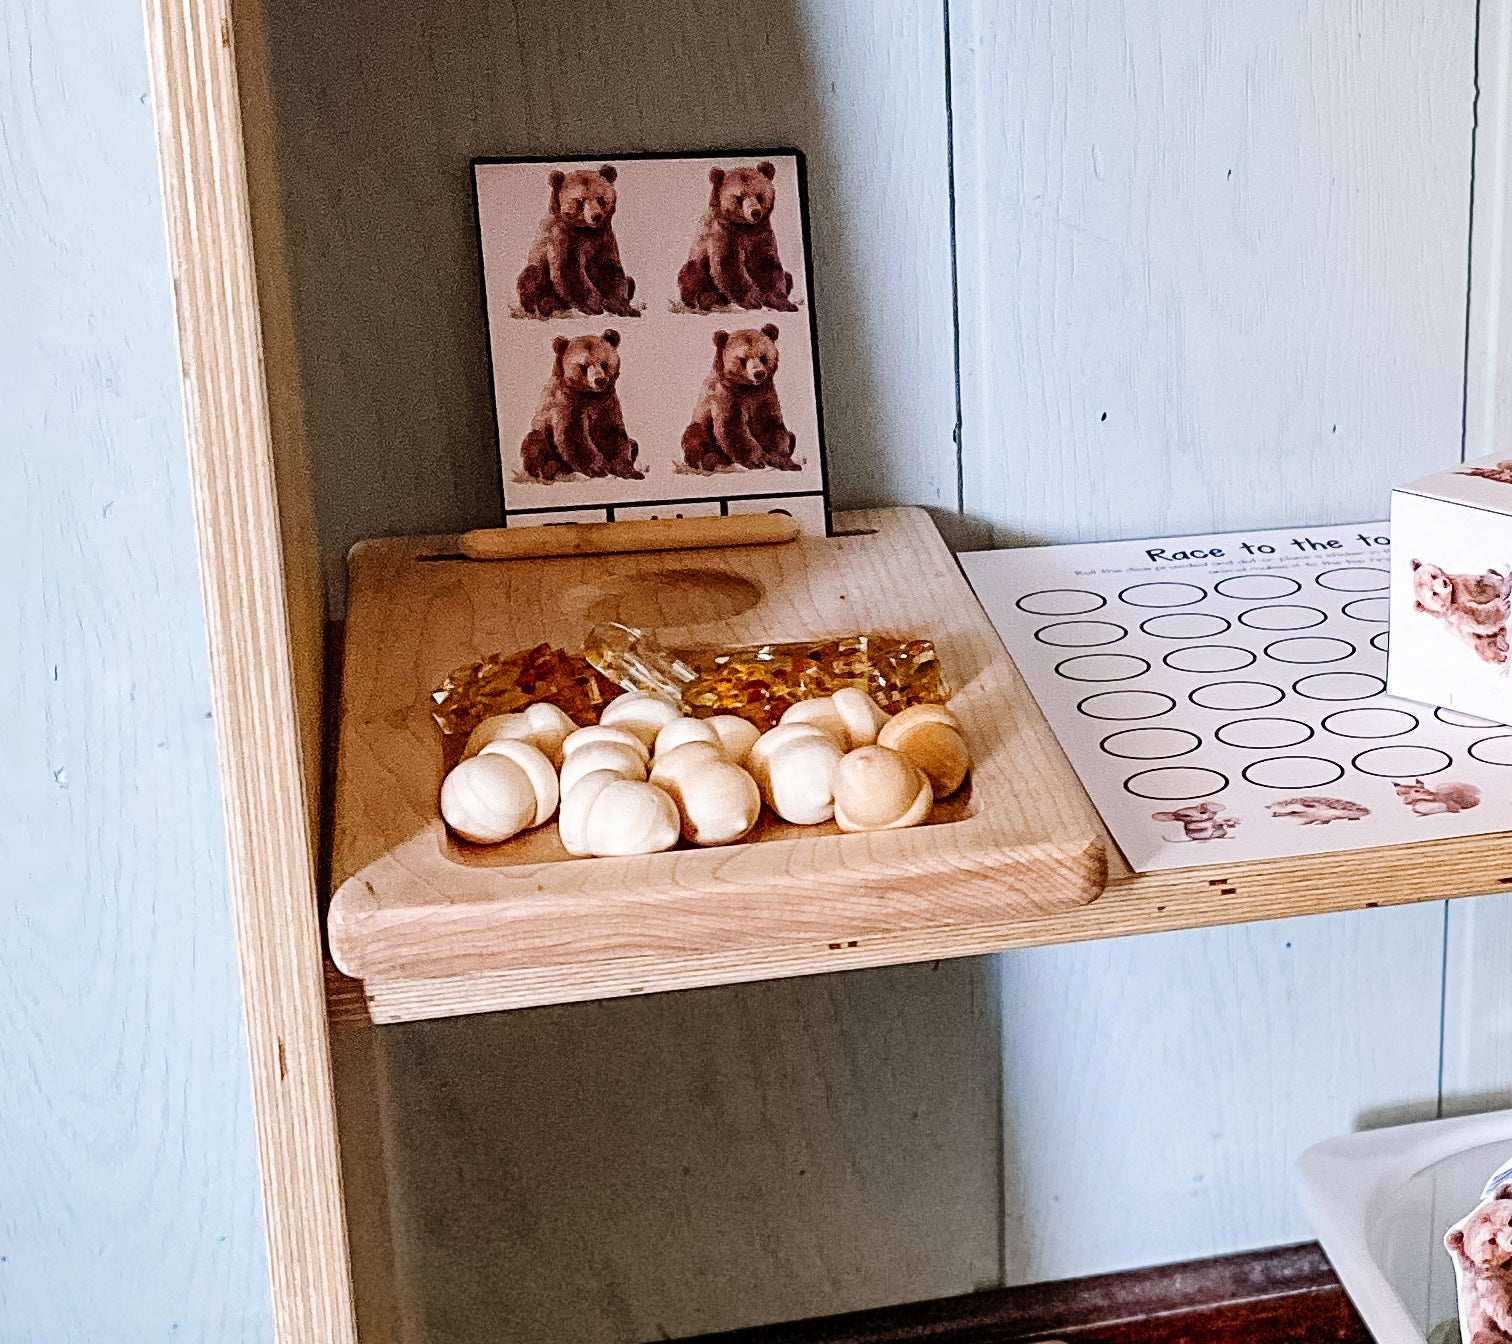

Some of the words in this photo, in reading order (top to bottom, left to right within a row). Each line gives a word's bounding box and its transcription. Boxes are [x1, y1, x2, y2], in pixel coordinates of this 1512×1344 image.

[1145, 547, 1225, 562] Race
[1239, 542, 1276, 555] to
[1290, 537, 1343, 552] the
